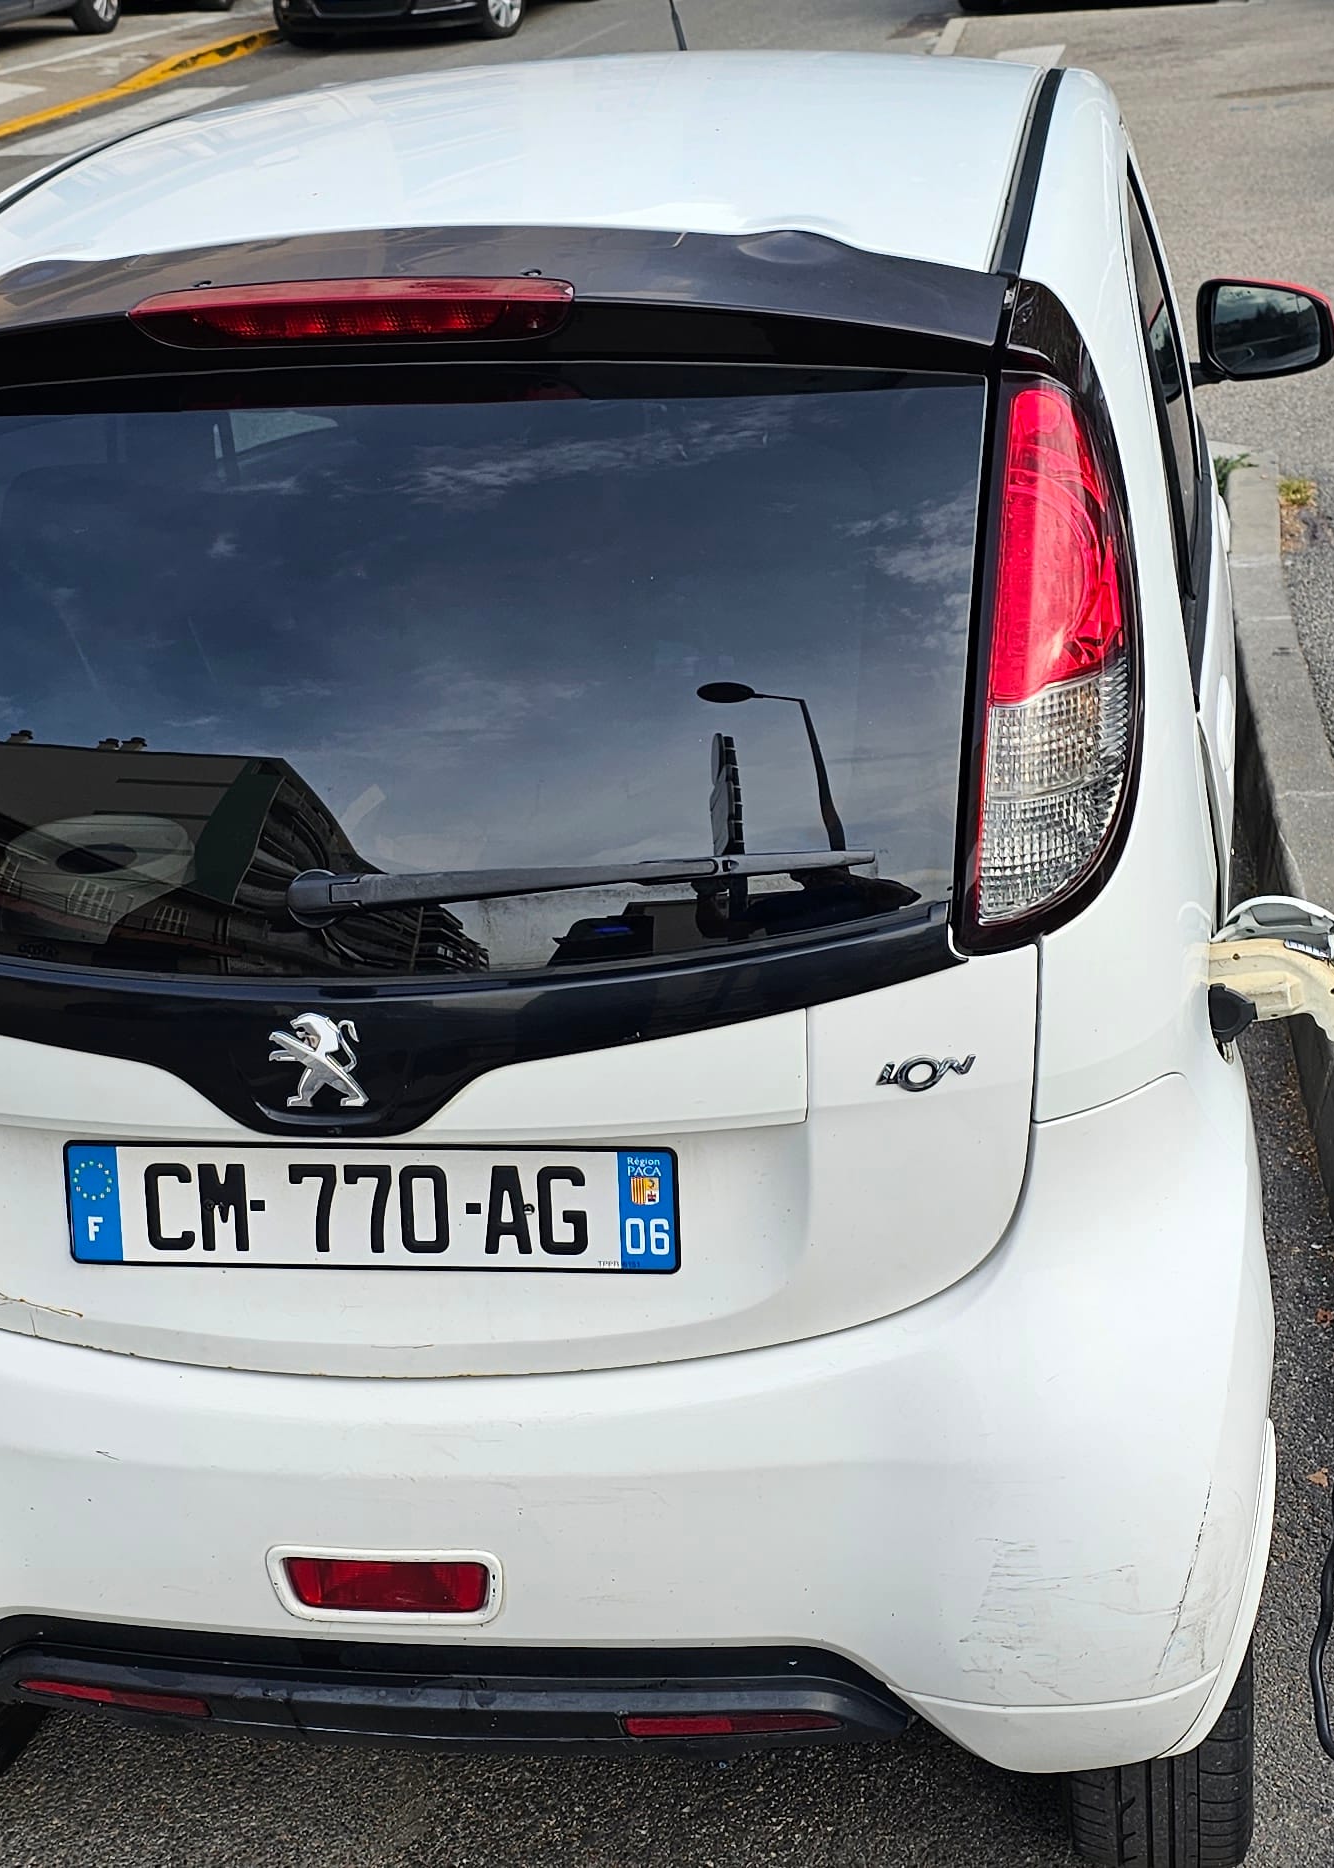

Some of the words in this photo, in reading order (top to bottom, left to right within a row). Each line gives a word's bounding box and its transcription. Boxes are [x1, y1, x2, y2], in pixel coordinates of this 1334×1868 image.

[626, 1156, 661, 1167] Région
[627, 1165, 662, 1177] PACA
[87, 1215, 104, 1242] F
[624, 1217, 670, 1256] 06
